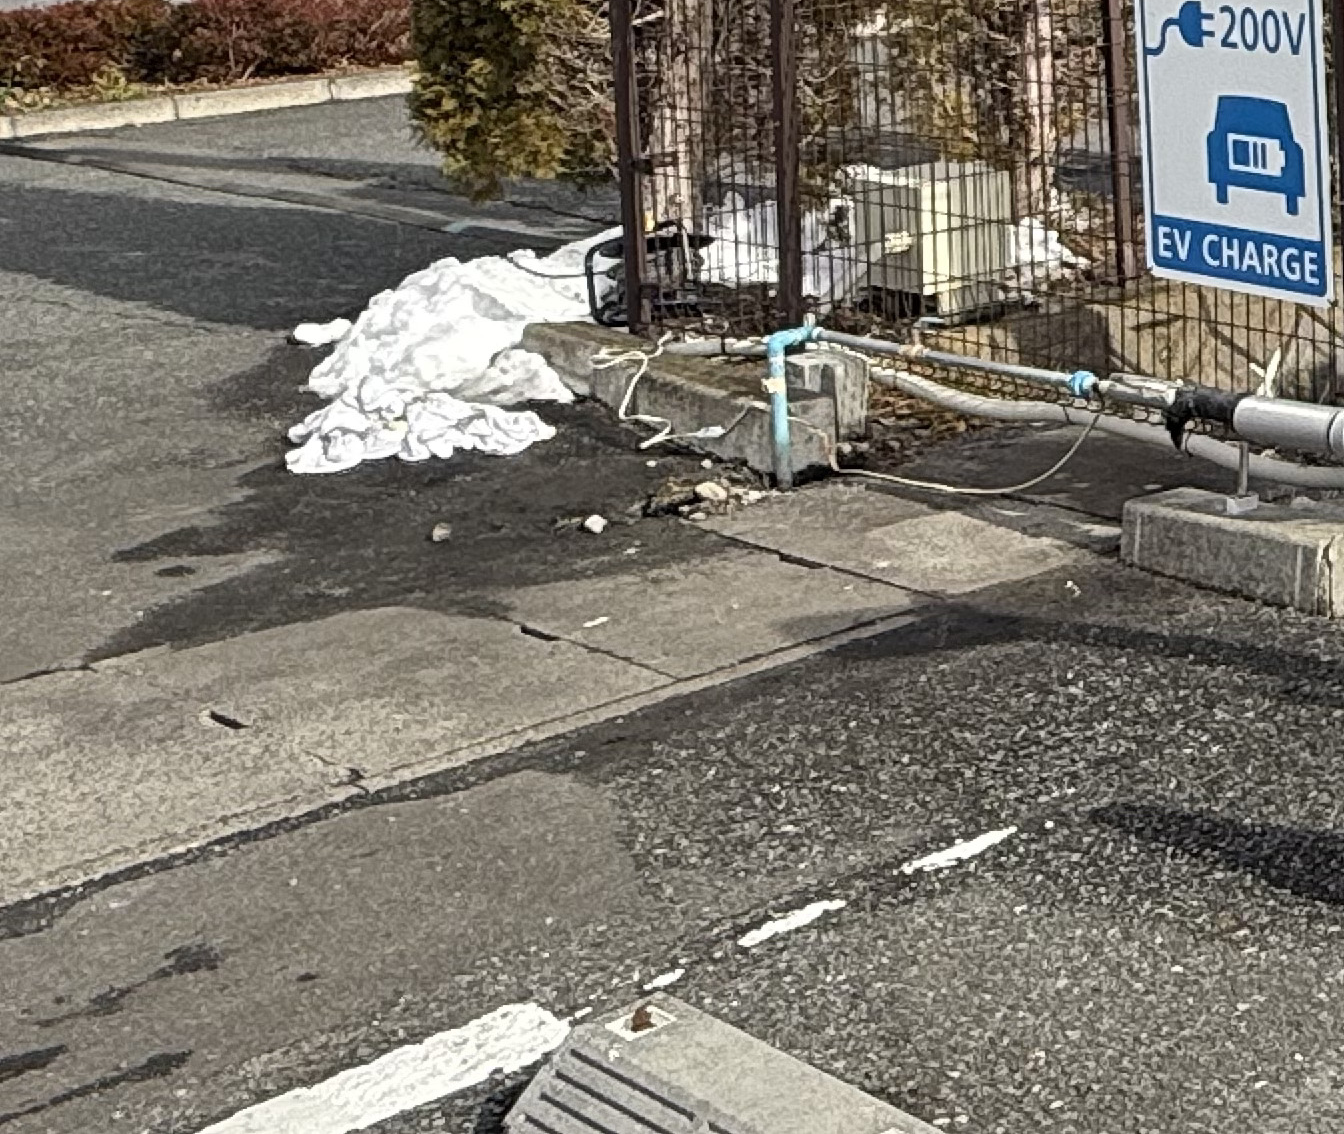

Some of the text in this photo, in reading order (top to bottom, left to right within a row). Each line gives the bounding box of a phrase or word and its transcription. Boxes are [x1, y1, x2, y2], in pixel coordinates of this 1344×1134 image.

[1219, 5, 1306, 56] 200V
[1158, 226, 1320, 284] EV CHARGE
